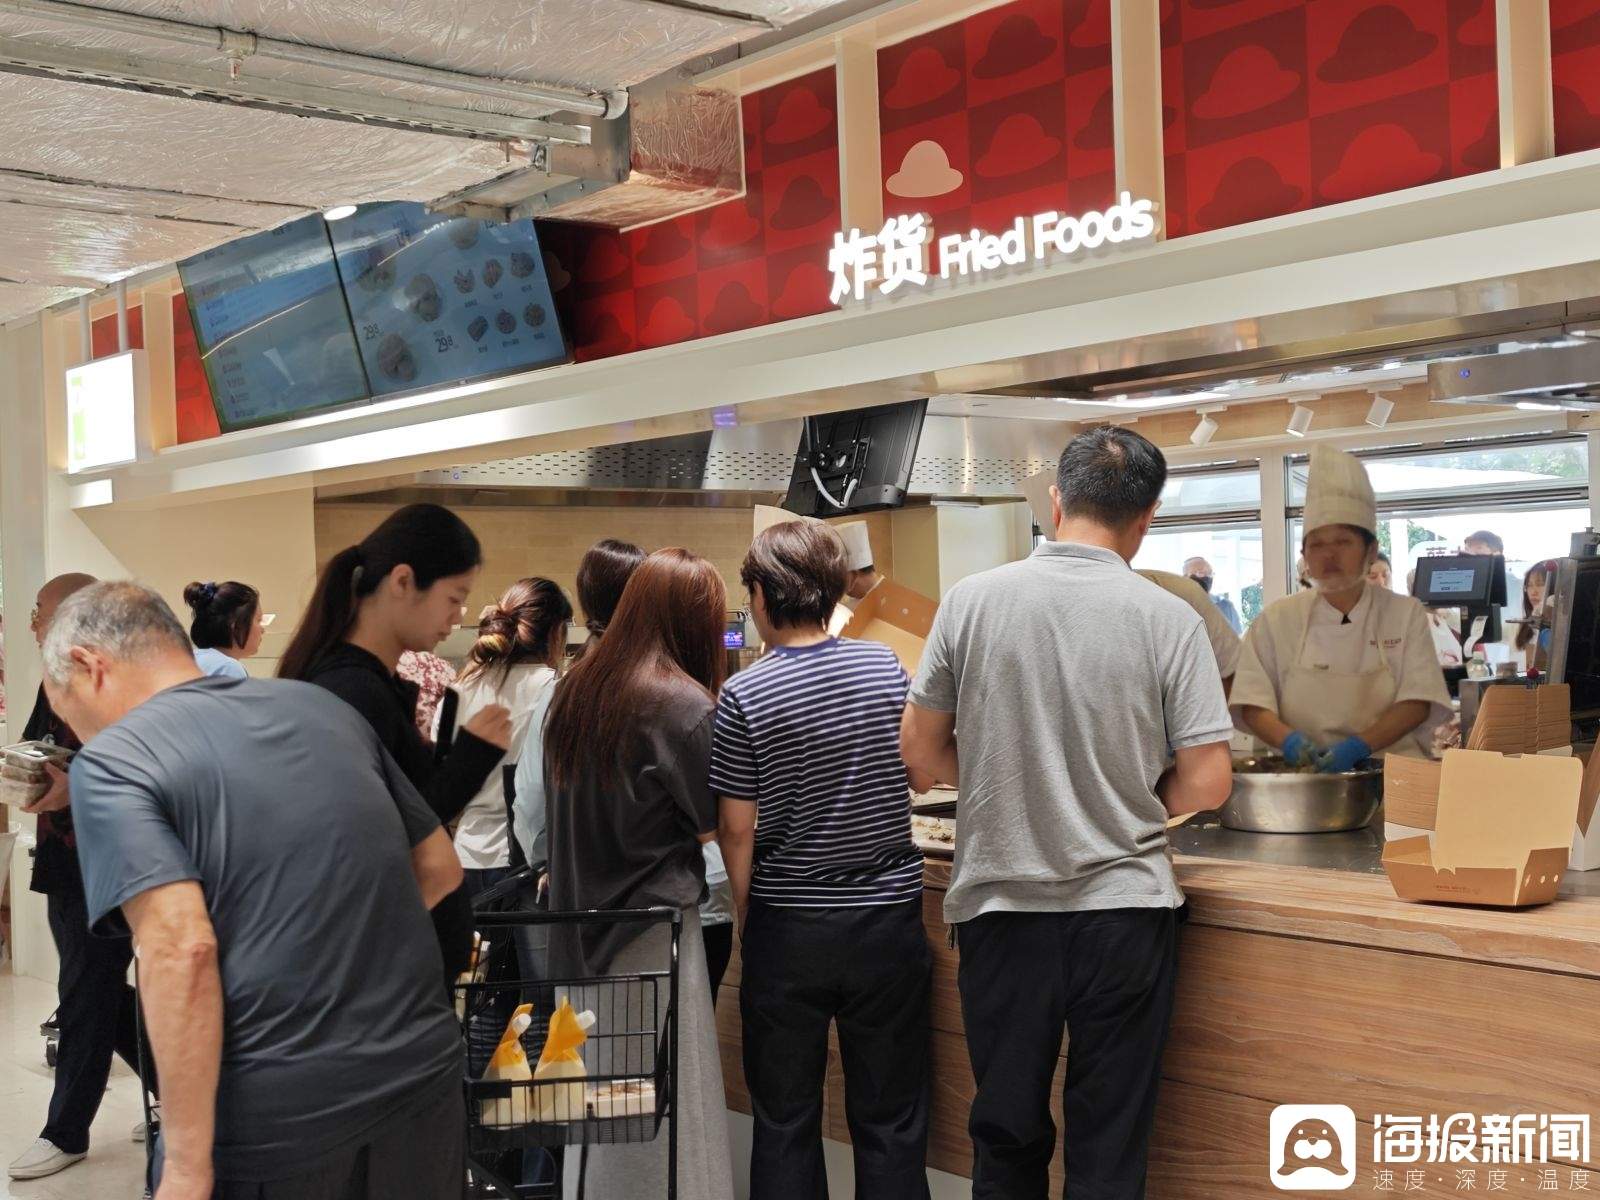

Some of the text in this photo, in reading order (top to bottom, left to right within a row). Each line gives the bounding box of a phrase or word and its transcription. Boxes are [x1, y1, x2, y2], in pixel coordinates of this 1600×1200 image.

[828, 191, 1155, 305] 炸货 Fried Foods
